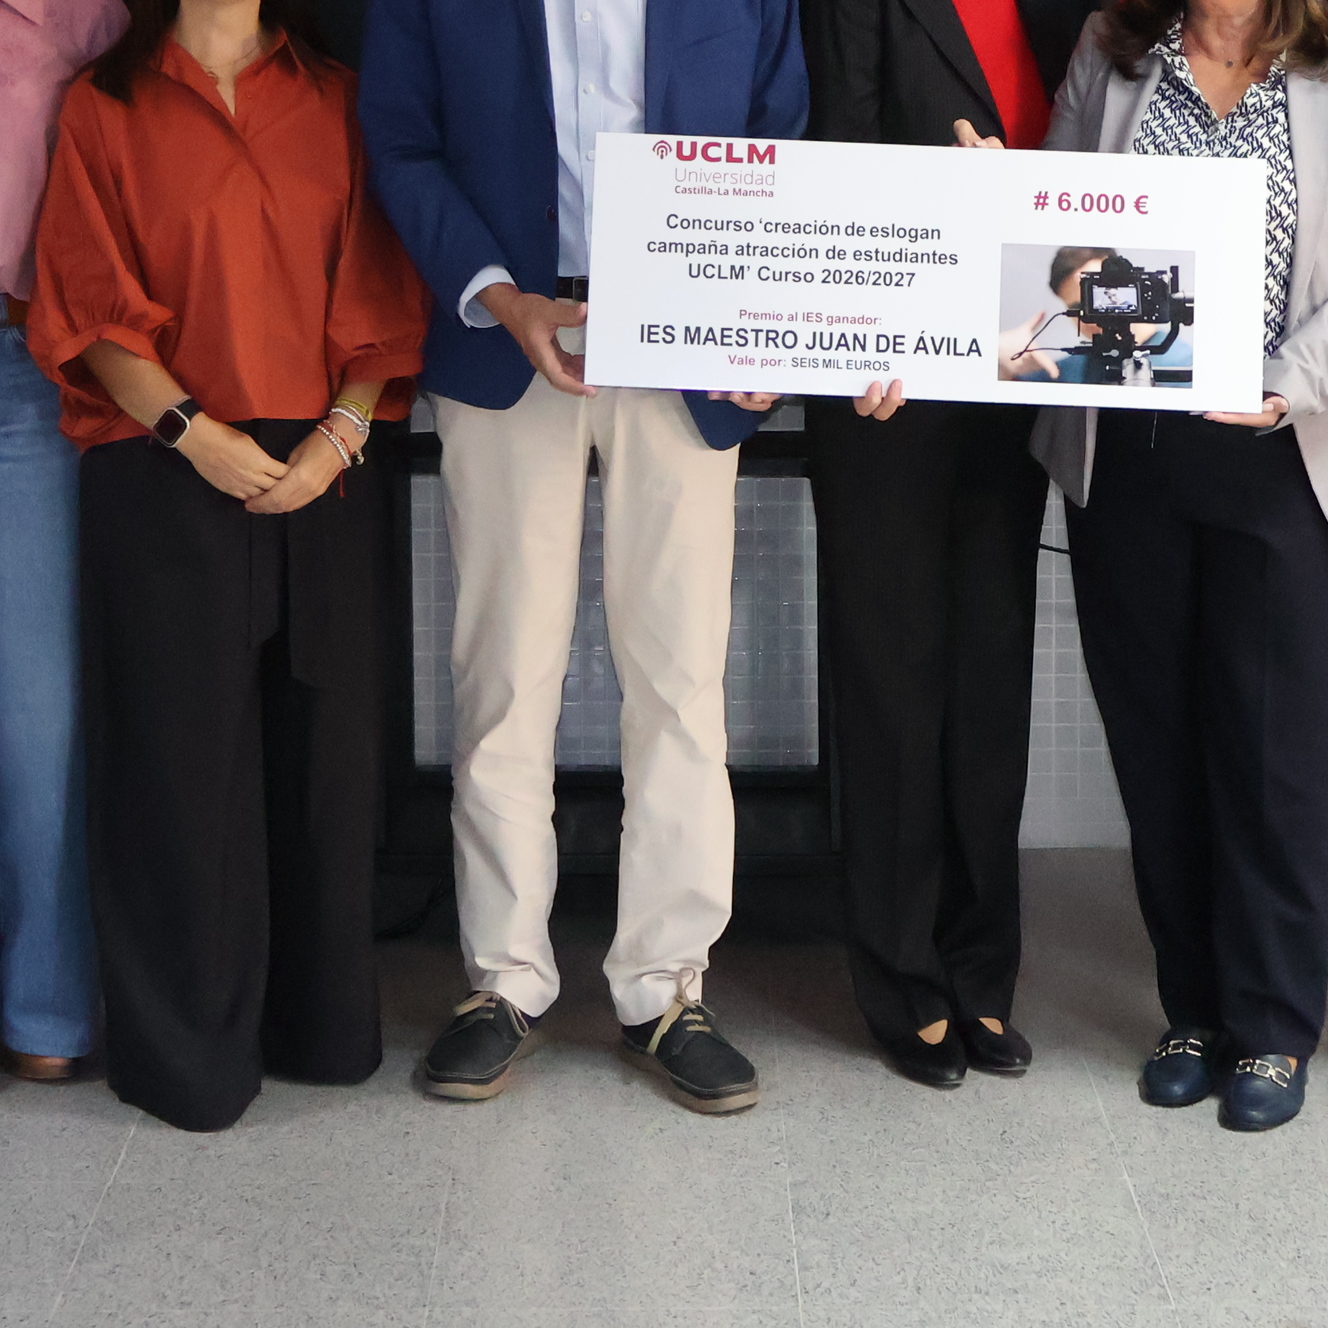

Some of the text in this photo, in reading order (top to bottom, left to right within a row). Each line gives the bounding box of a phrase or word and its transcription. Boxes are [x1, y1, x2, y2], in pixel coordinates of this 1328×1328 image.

[676, 140, 776, 165] UCLM
[674, 167, 775, 186] Universidad
[674, 185, 774, 198] Castilla-La Mancha
[1057, 191, 1125, 214] 6.000
[1133, 194, 1149, 215] €
[666, 213, 755, 232] Concurso
[844, 221, 866, 237] de
[869, 223, 941, 243] eslogan
[646, 239, 959, 265] campaña atracción de estudiantes
[757, 265, 815, 283] Curso
[820, 268, 916, 287] 2026/2027
[739, 309, 882, 326] Premio al IES ganador:
[639, 323, 983, 357] IES MAESTRO JUAN DE ÁVILA
[728, 354, 891, 372] Vale por: SEIS MIL EUROS
